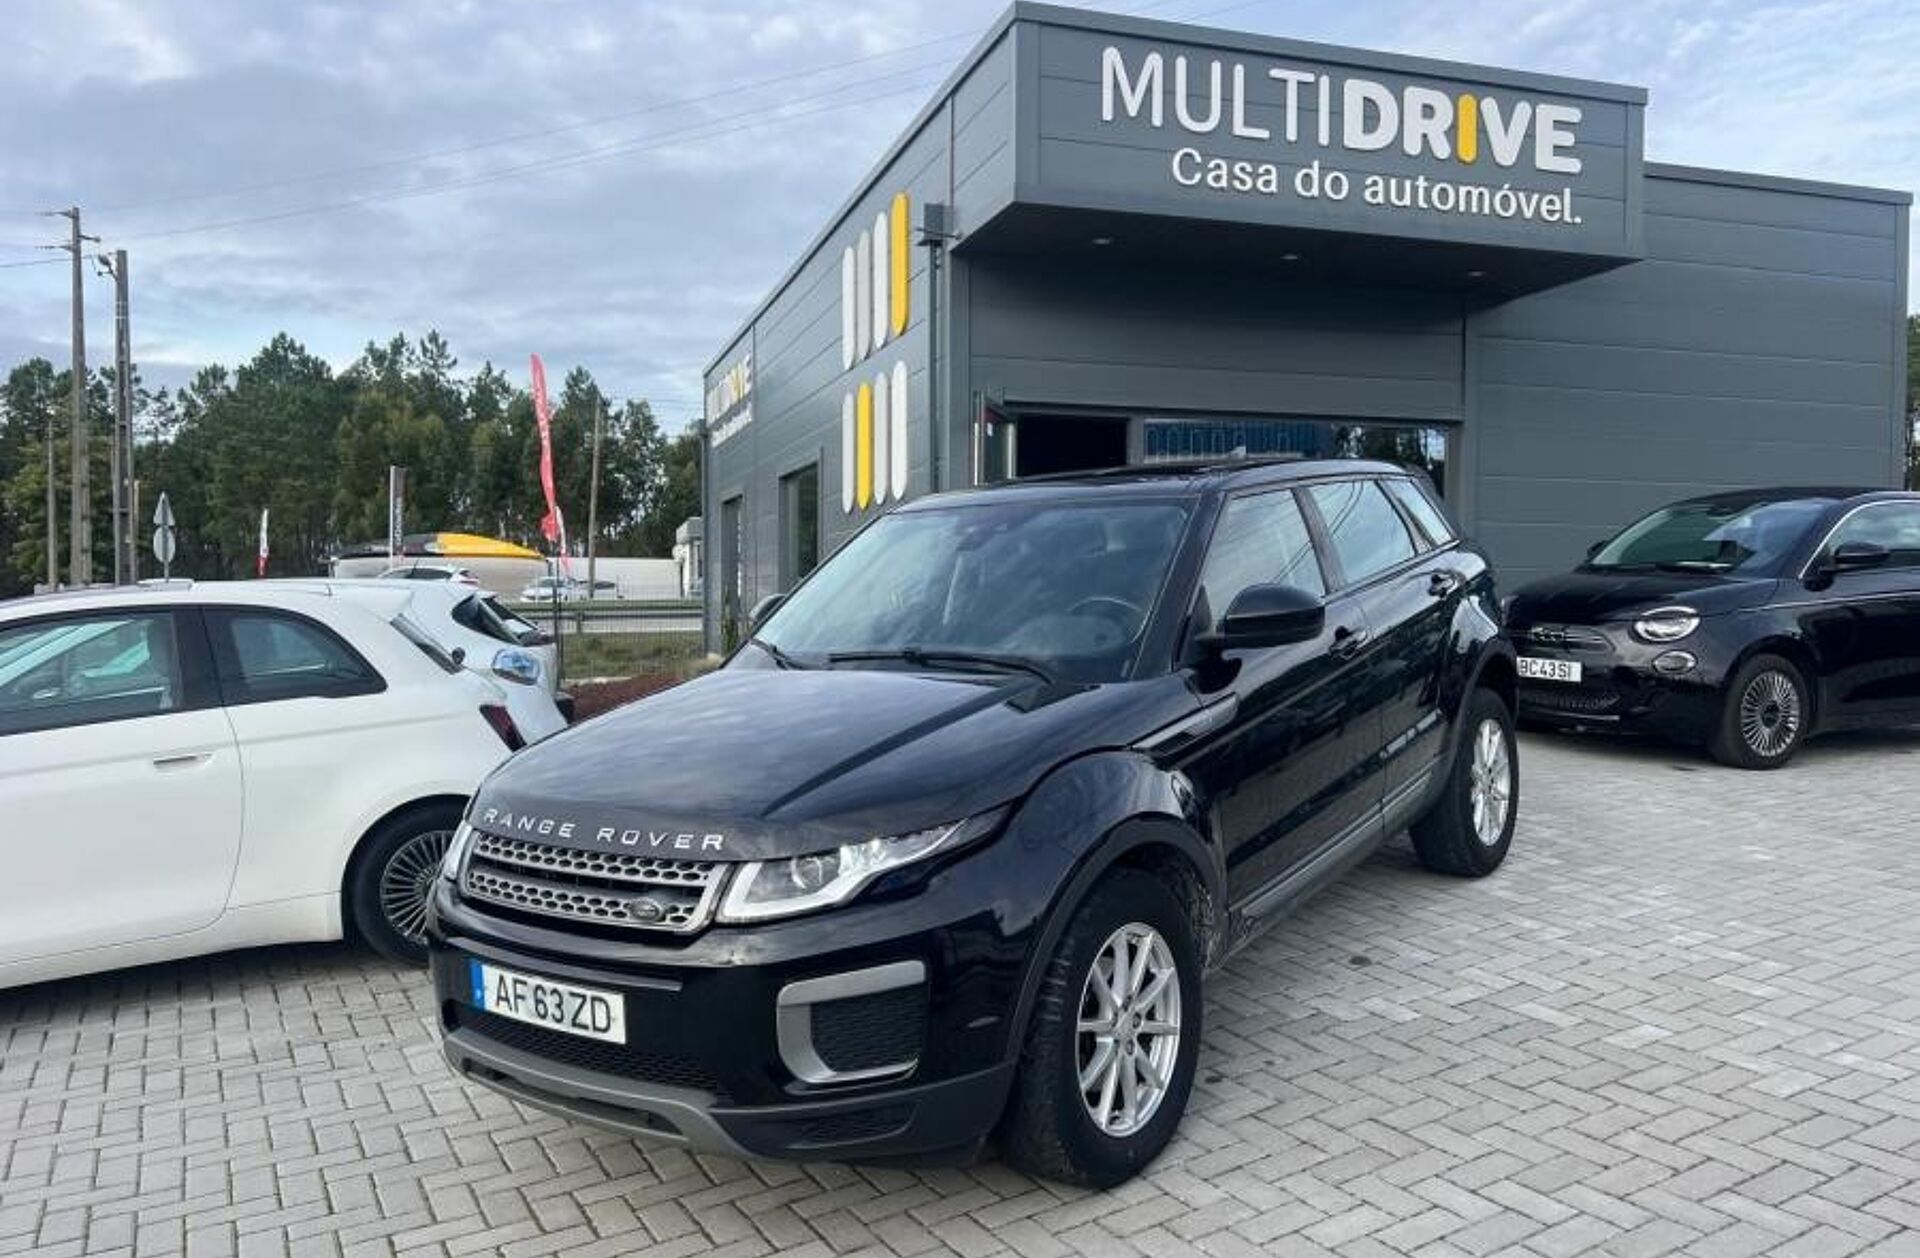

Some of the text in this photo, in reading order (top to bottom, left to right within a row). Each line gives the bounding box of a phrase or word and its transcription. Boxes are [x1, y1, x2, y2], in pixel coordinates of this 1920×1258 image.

[1101, 46, 1582, 174] MULTIDRIVE
[1171, 147, 1582, 224] Casa do automóvel.
[483, 808, 724, 851] RANGE ROVER
